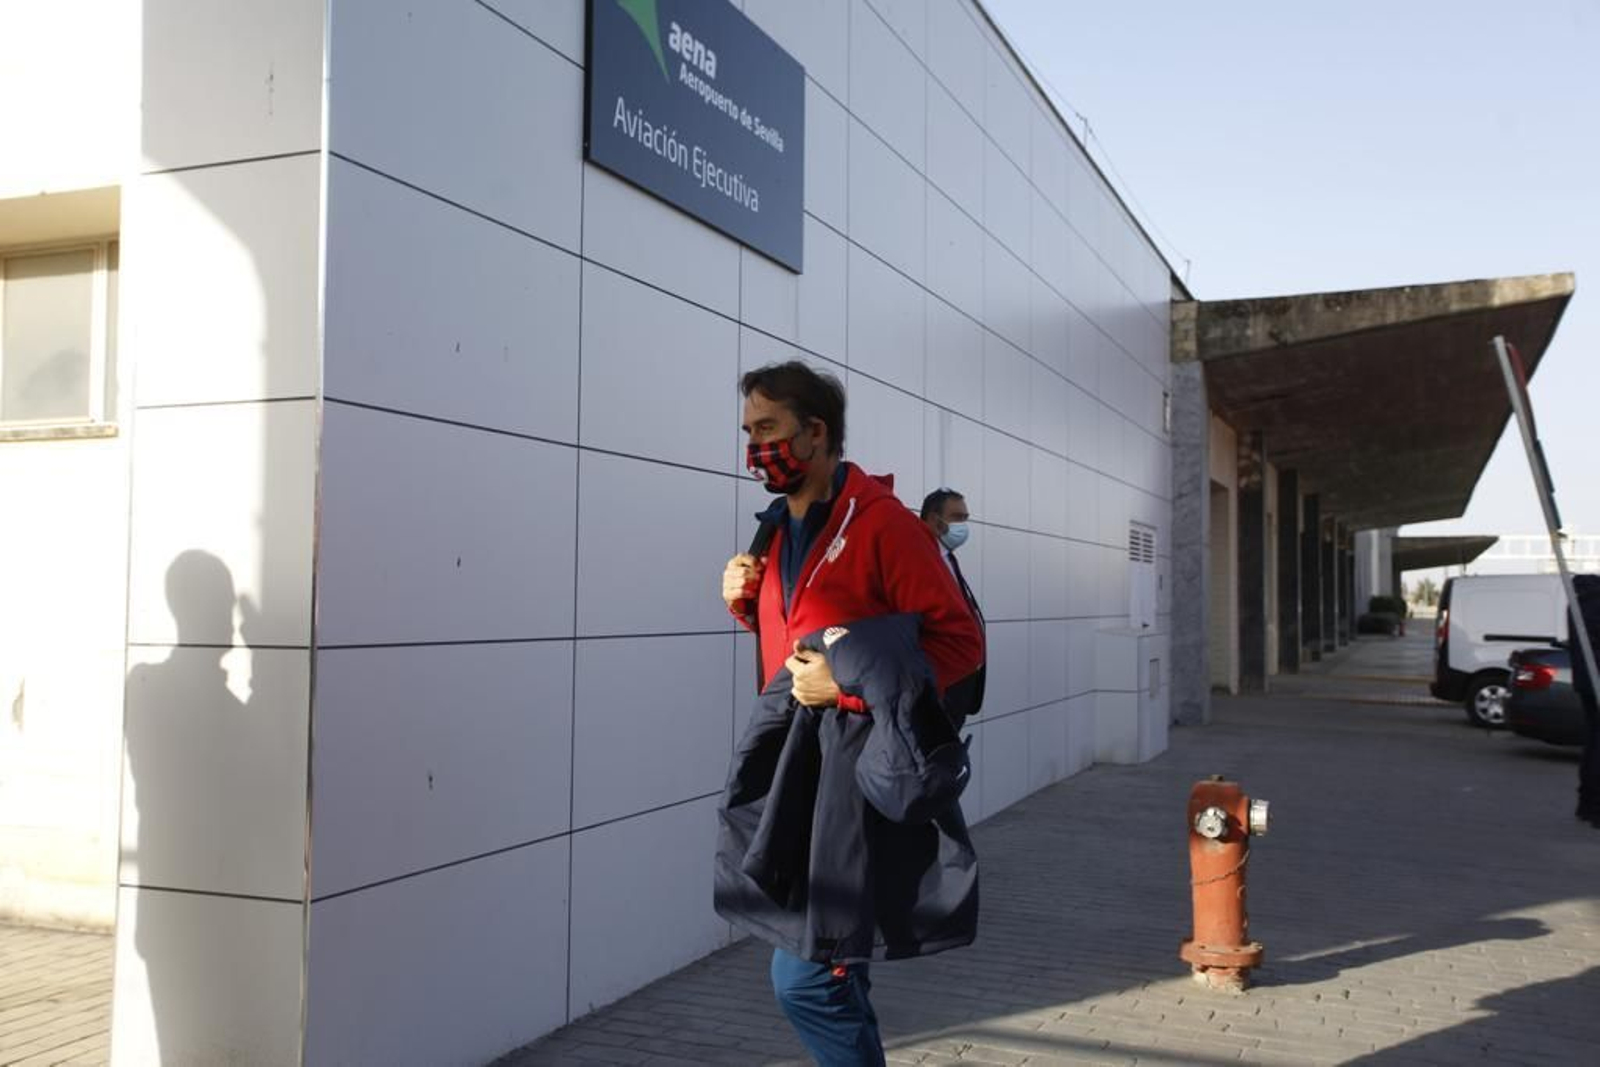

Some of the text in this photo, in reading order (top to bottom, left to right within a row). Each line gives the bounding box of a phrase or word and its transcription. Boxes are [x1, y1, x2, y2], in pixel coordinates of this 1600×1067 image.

[668, 21, 717, 79] aena
[679, 62, 784, 152] Aeropuerto de Sevilla
[613, 96, 759, 213] Aviación Ejecutiva
